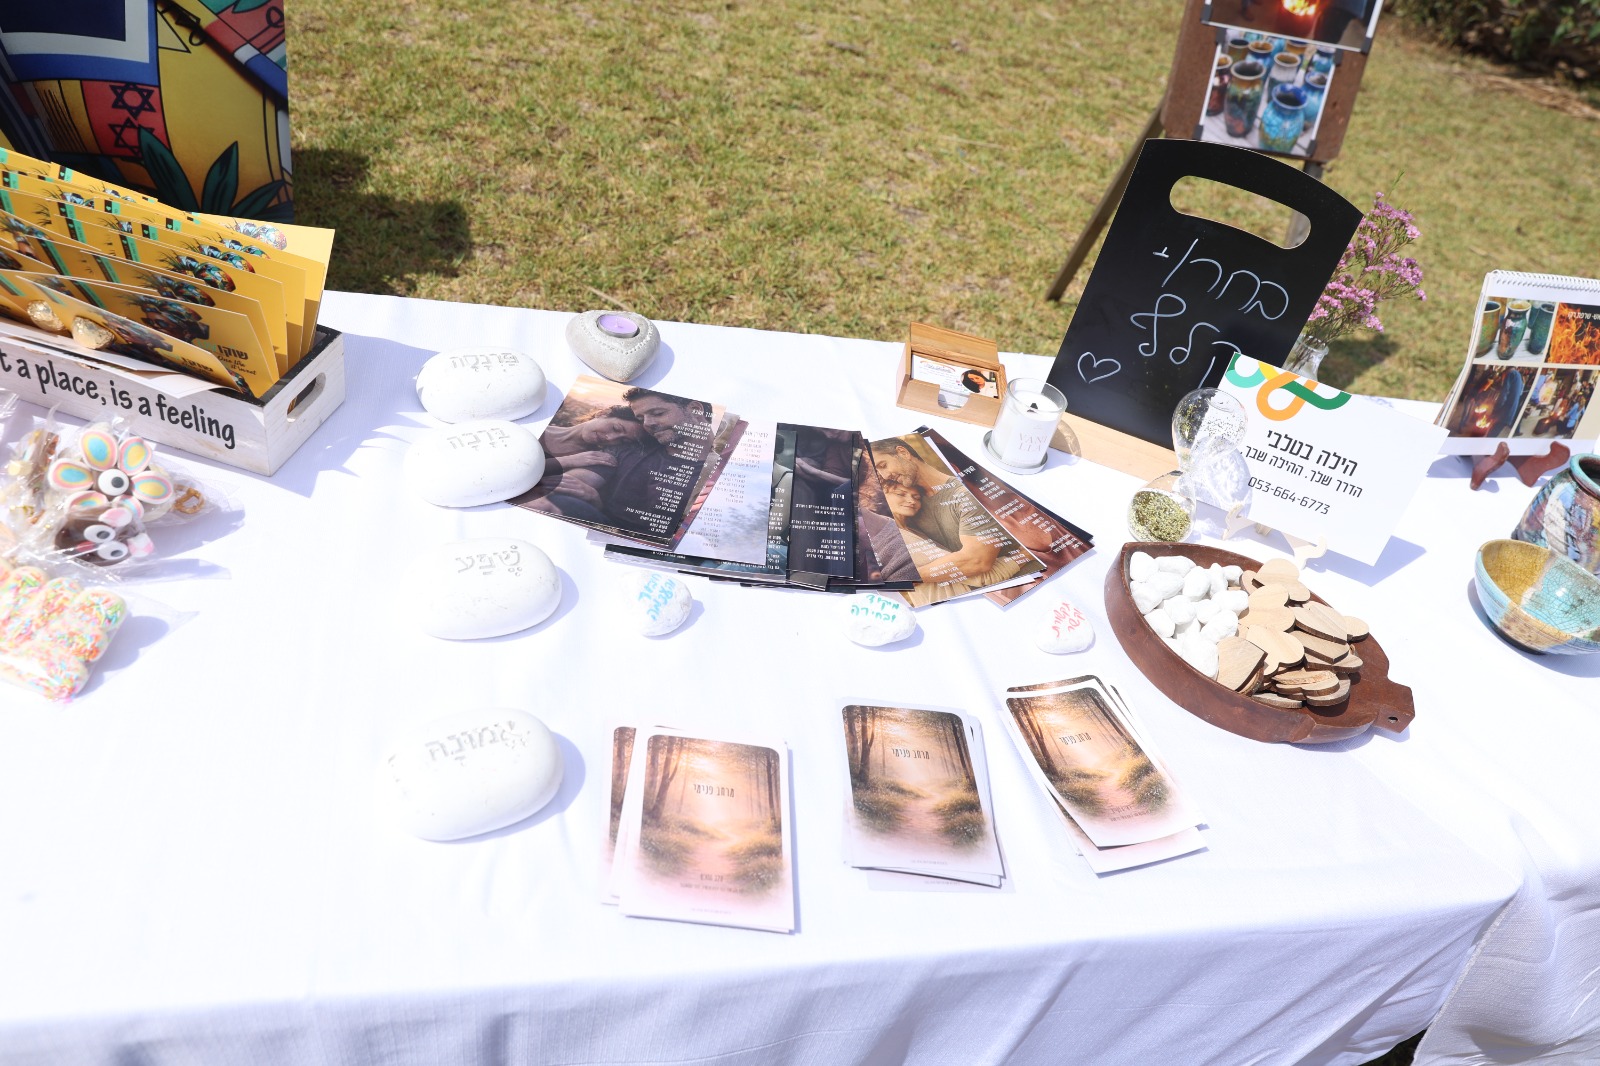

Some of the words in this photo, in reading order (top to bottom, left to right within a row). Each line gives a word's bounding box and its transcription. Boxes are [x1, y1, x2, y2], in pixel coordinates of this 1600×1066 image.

[17, 358, 31, 379] a
[35, 360, 106, 406] place,
[110, 379, 133, 410] is
[138, 396, 152, 417] a
[155, 393, 236, 450] feeling
[1267, 430, 1314, 461] בטלבי
[1268, 455, 1304, 476] ההילה
[1316, 450, 1358, 477] הילה
[1247, 476, 1330, 515] 053-664-6773
[1336, 479, 1363, 498] הדרך
[850, 604, 897, 623] ובחירה
[891, 748, 911, 759] פנימי
[913, 750, 930, 760] מרחב
[693, 783, 714, 795] פנימי
[716, 787, 735, 798] מרחב
